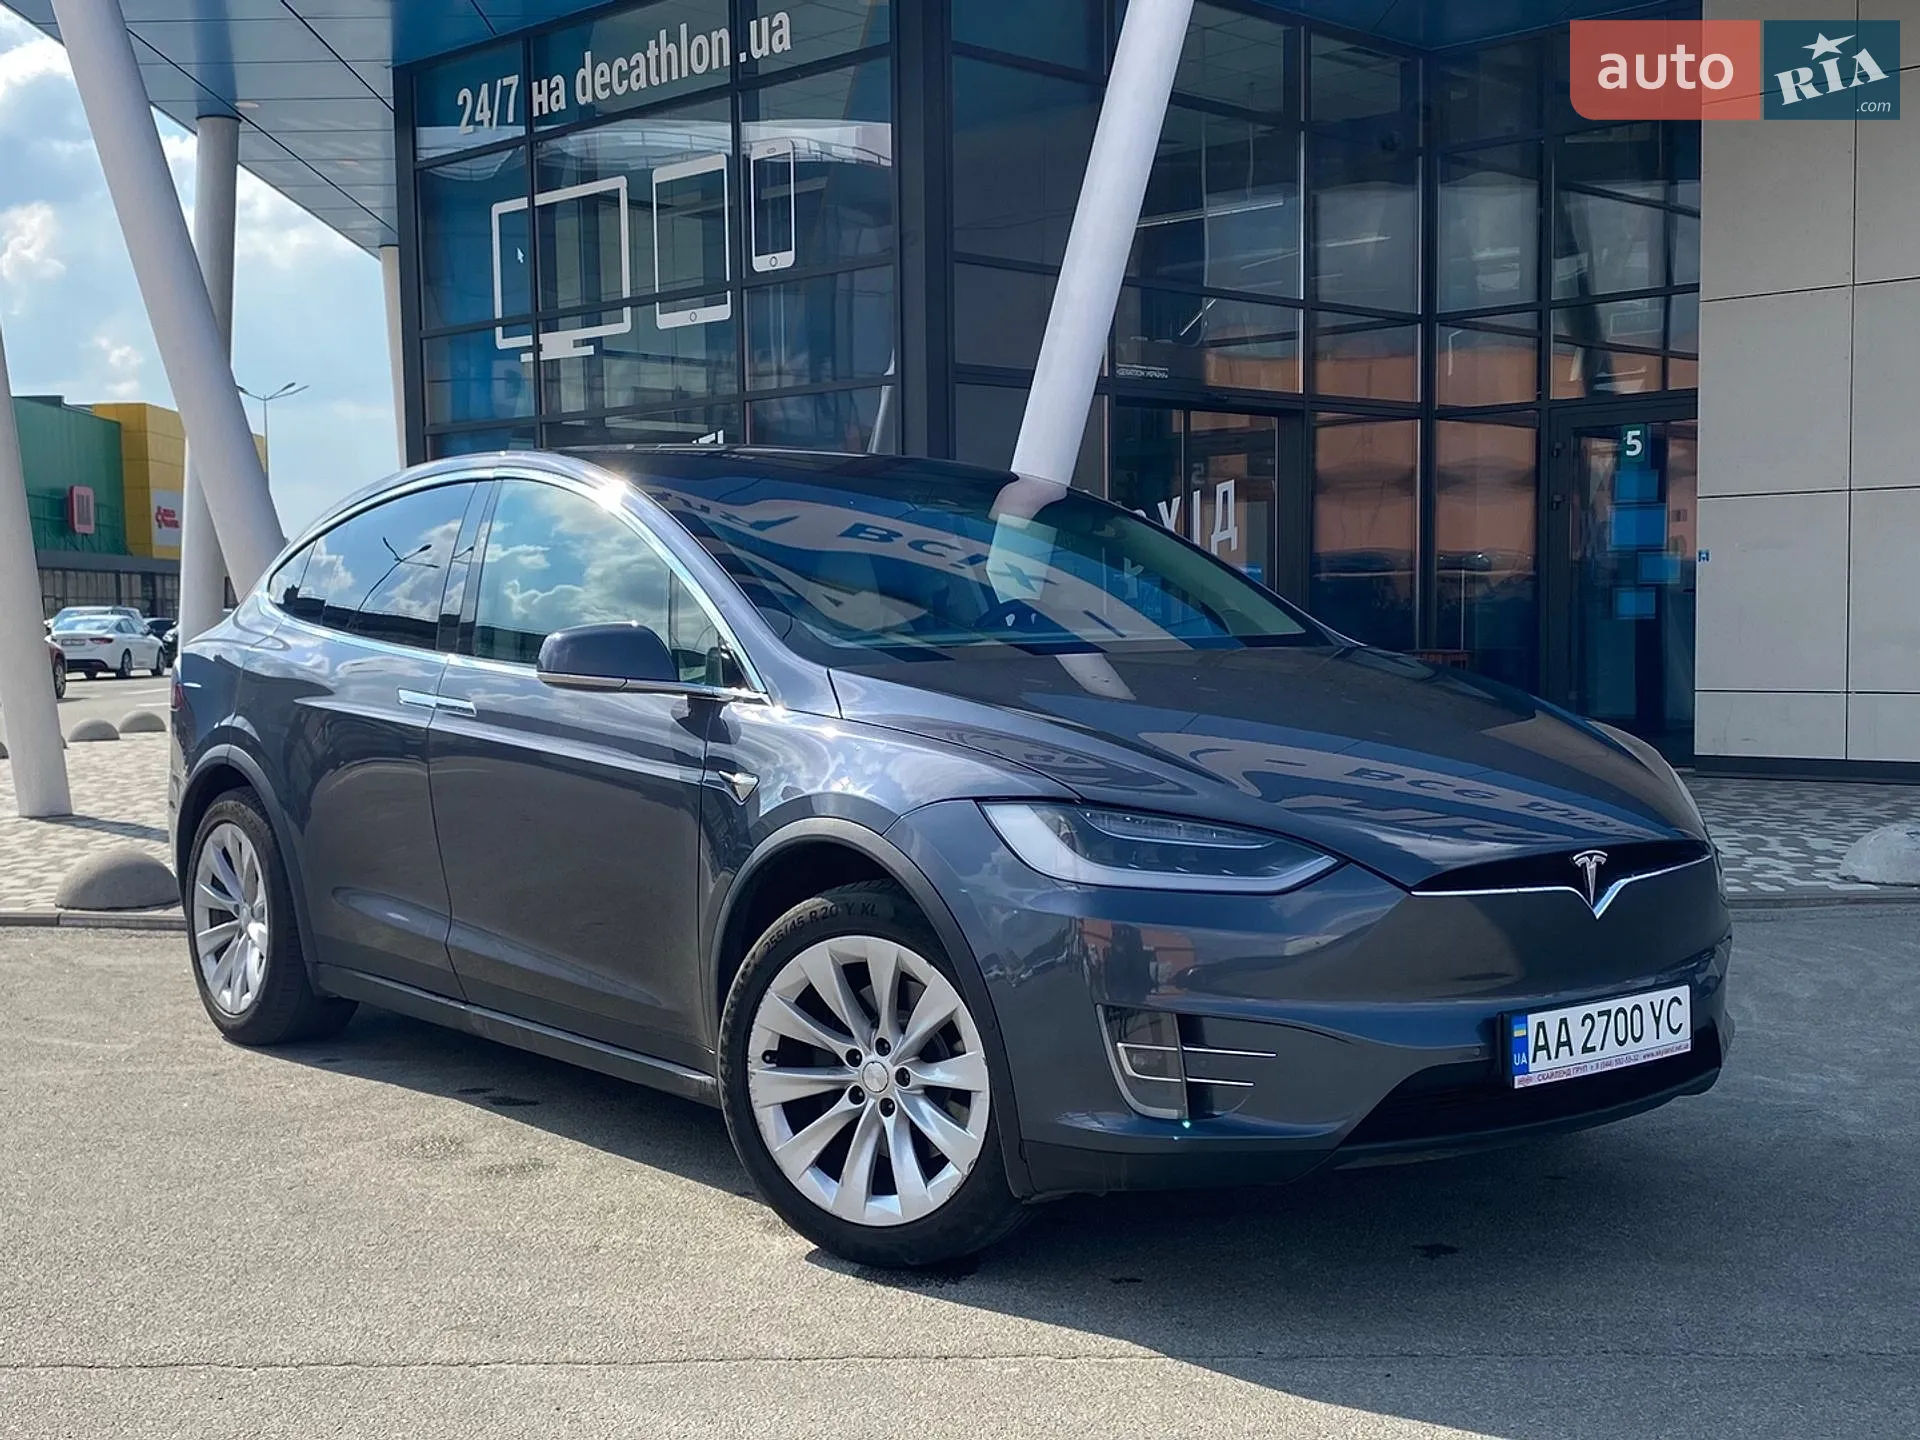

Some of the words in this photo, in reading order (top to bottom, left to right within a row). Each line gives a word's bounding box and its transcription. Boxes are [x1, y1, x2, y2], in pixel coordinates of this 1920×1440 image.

[457, 74, 520, 136] 24/7
[532, 73, 567, 118] на
[1625, 429, 1643, 457] 5
[1531, 1017, 1574, 1063] AA
[1581, 1003, 1645, 1054] 2700
[1650, 996, 1684, 1040] YC
[1513, 1052, 1528, 1067] UA
